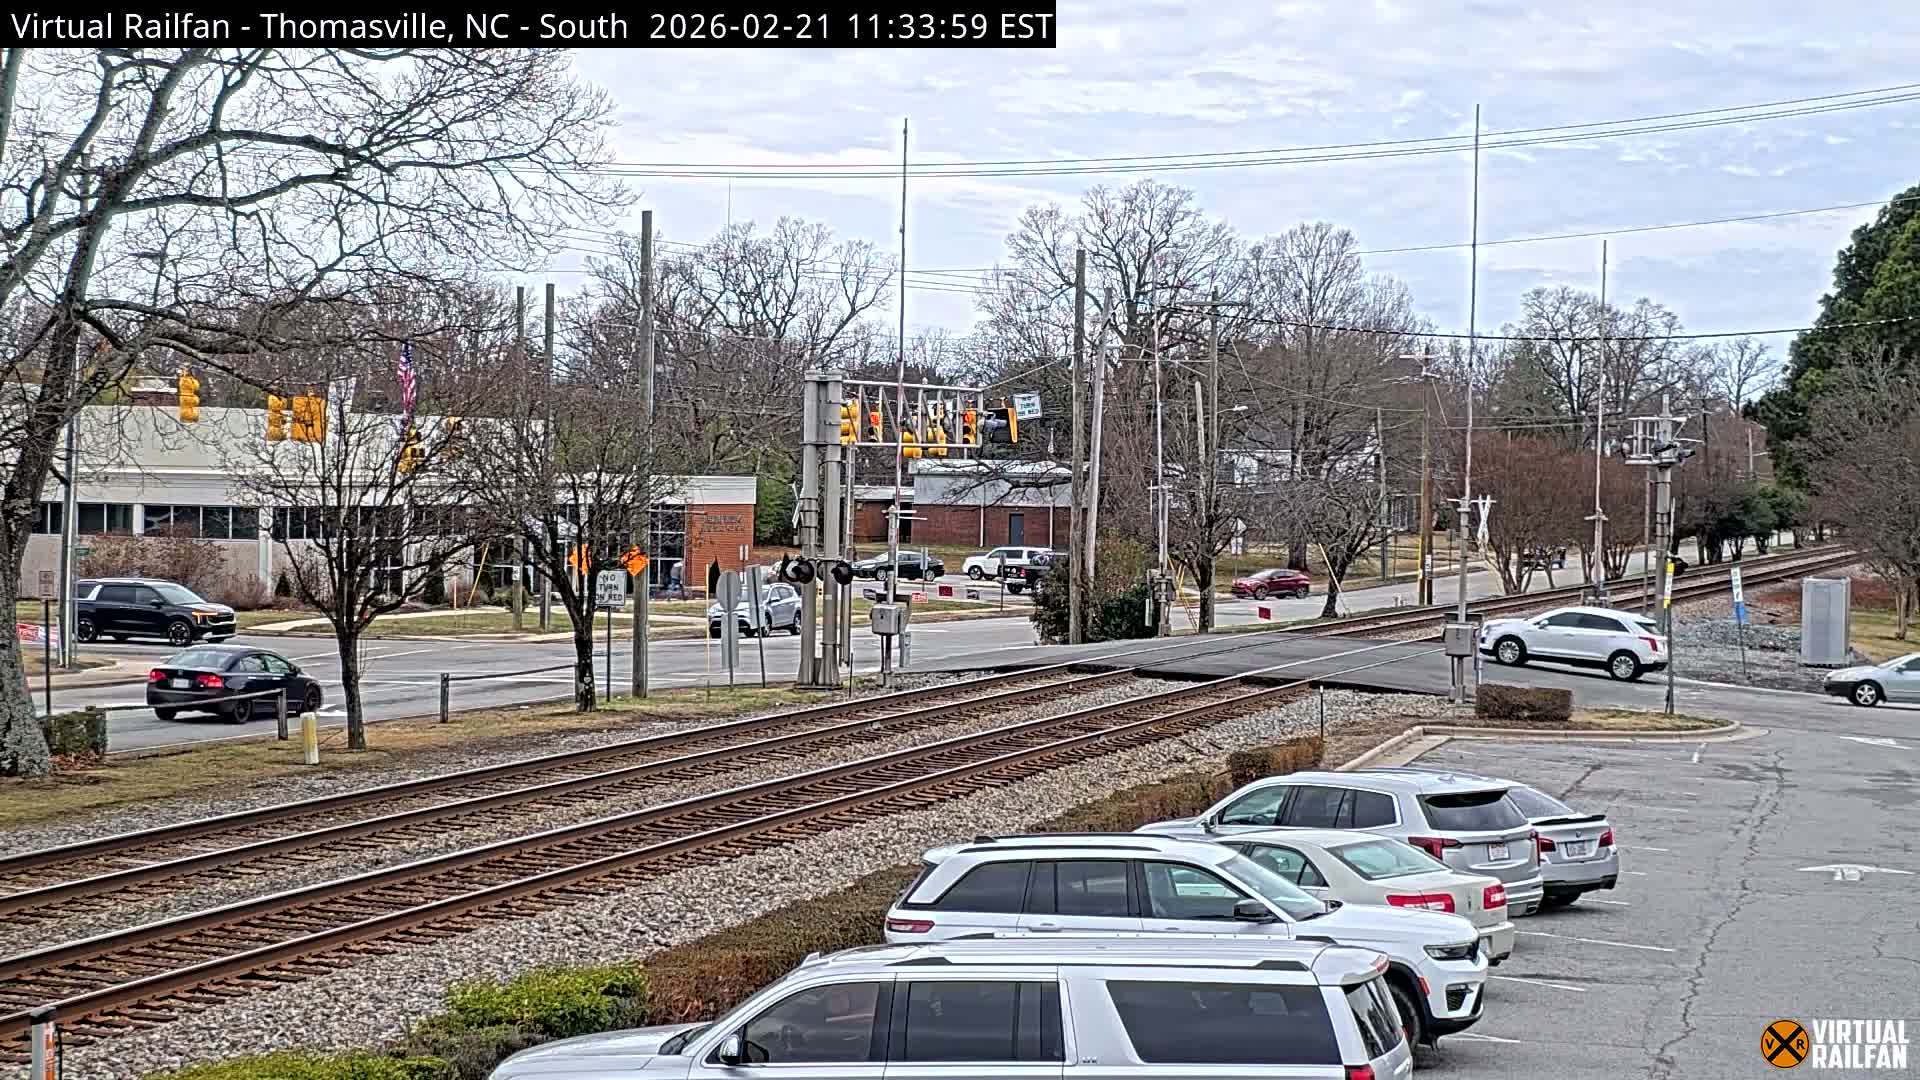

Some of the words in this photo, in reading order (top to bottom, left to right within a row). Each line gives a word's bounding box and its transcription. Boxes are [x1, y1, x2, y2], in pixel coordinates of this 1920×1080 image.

[601, 573, 616, 582] NO
[598, 583, 619, 592] TURN
[608, 593, 623, 601] RED
